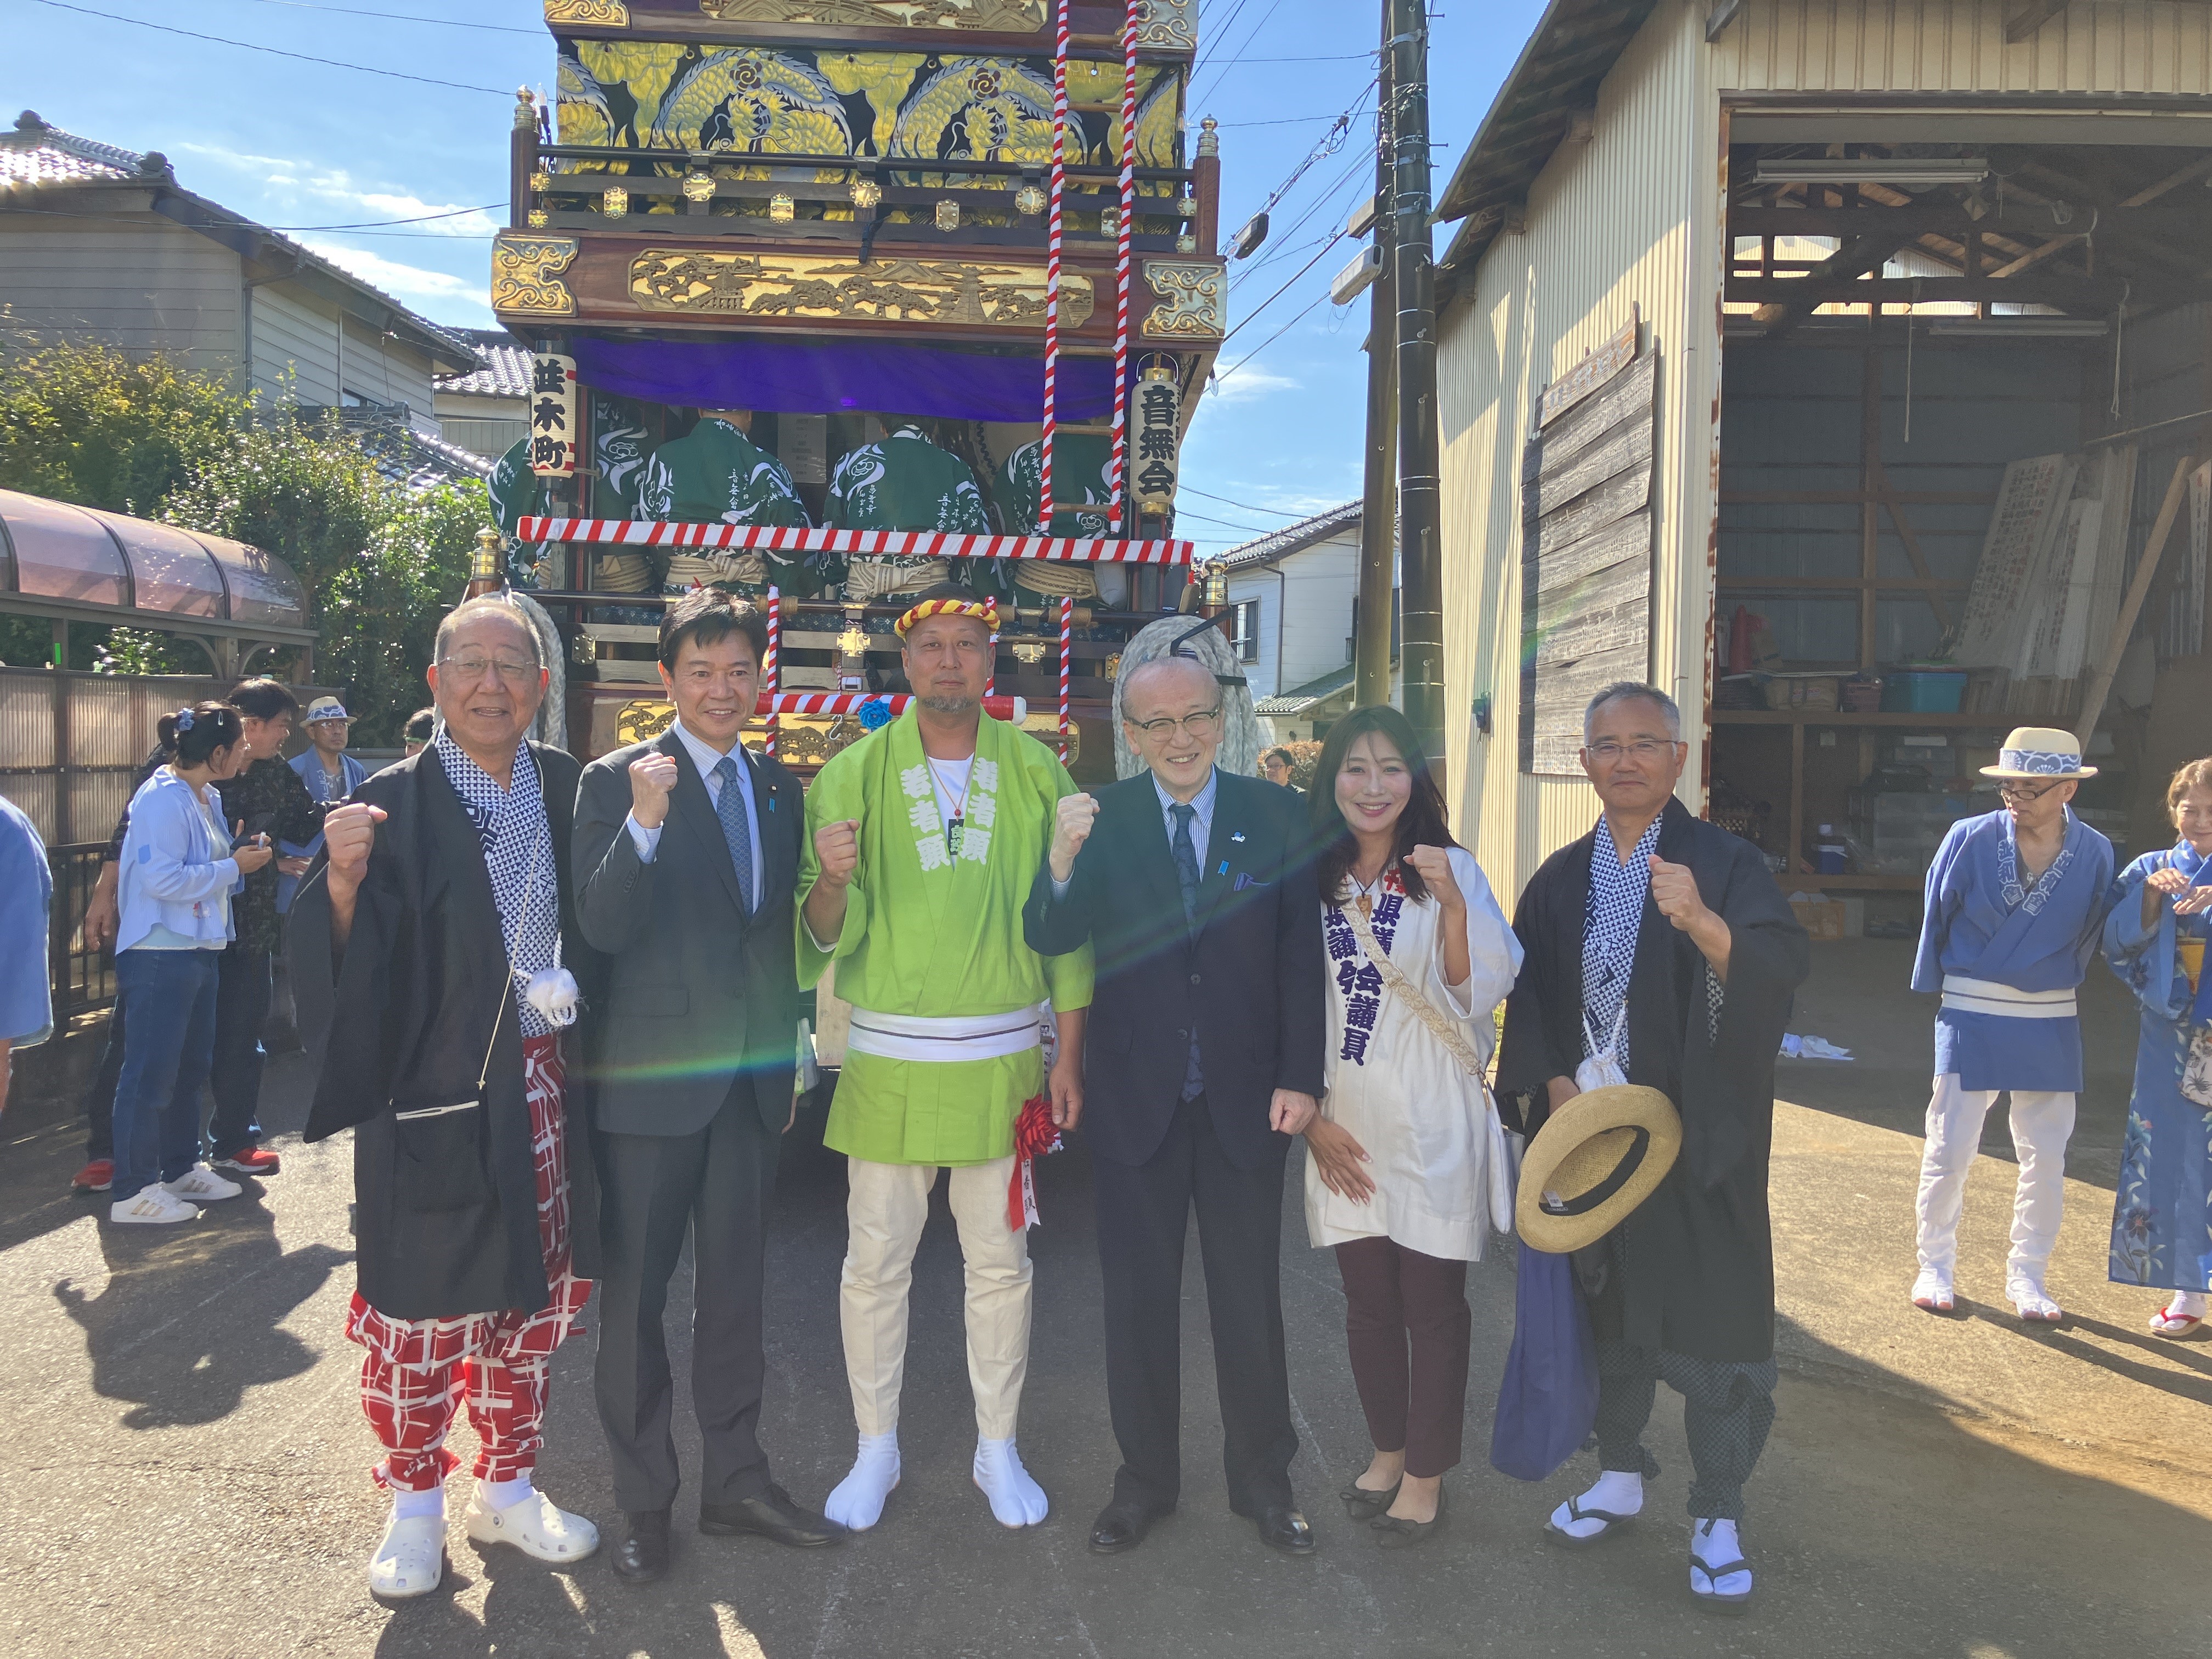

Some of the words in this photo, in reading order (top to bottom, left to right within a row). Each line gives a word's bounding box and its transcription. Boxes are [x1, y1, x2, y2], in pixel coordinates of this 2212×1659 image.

[534, 359, 567, 469] 並木町
[1138, 385, 1176, 496] 音無会
[900, 764, 951, 872] 若者頭
[959, 757, 999, 865] 若者頭
